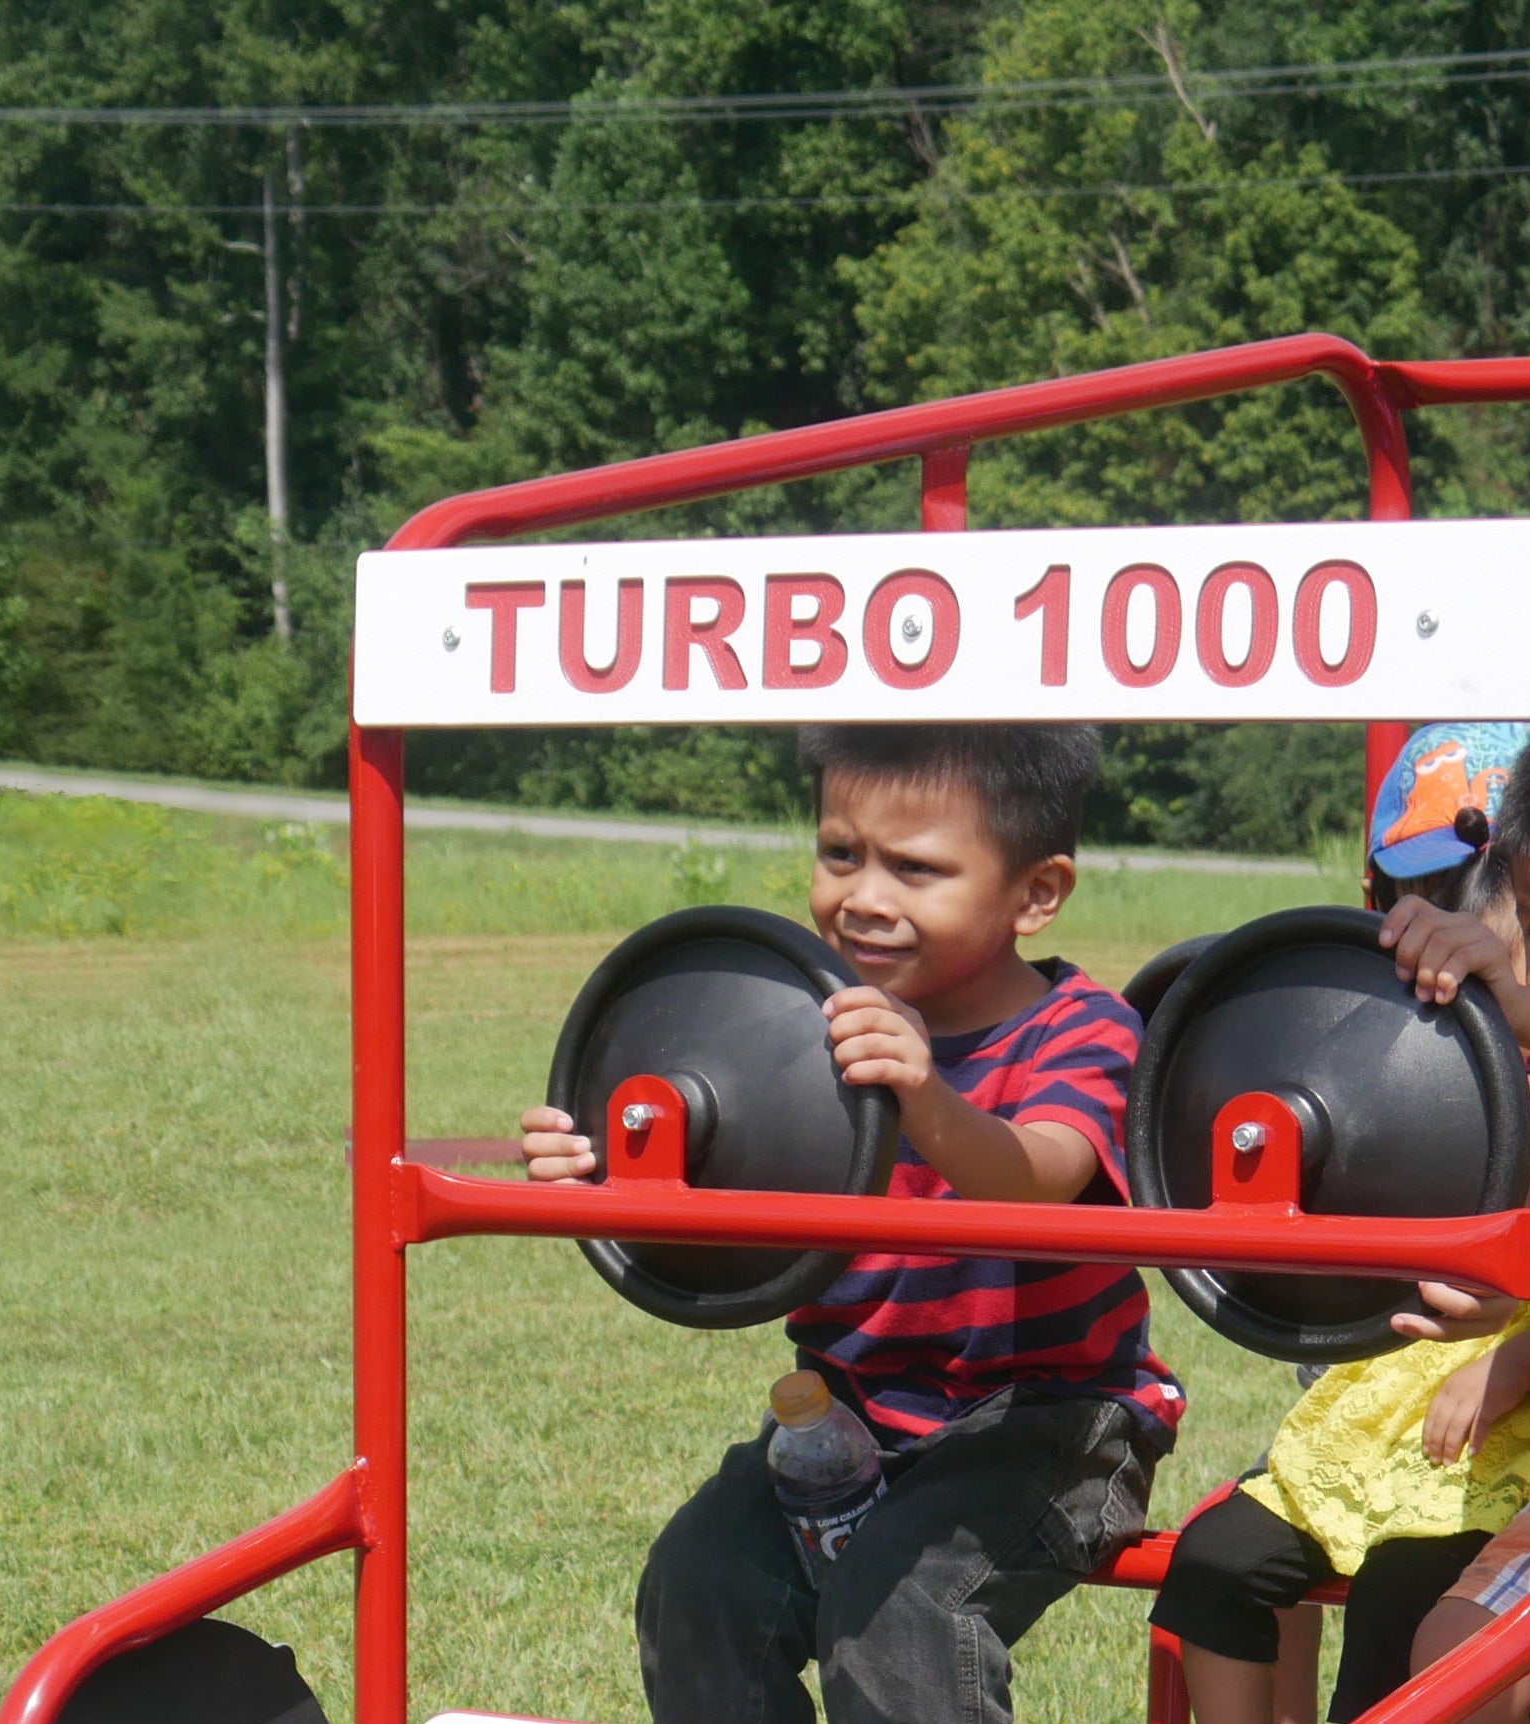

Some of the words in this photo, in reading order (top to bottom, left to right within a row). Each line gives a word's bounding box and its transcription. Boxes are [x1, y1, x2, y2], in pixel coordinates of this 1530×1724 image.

[466, 569, 960, 694] TURBO
[1014, 559, 1378, 689] 1000
[816, 1516, 839, 1528] LOW
